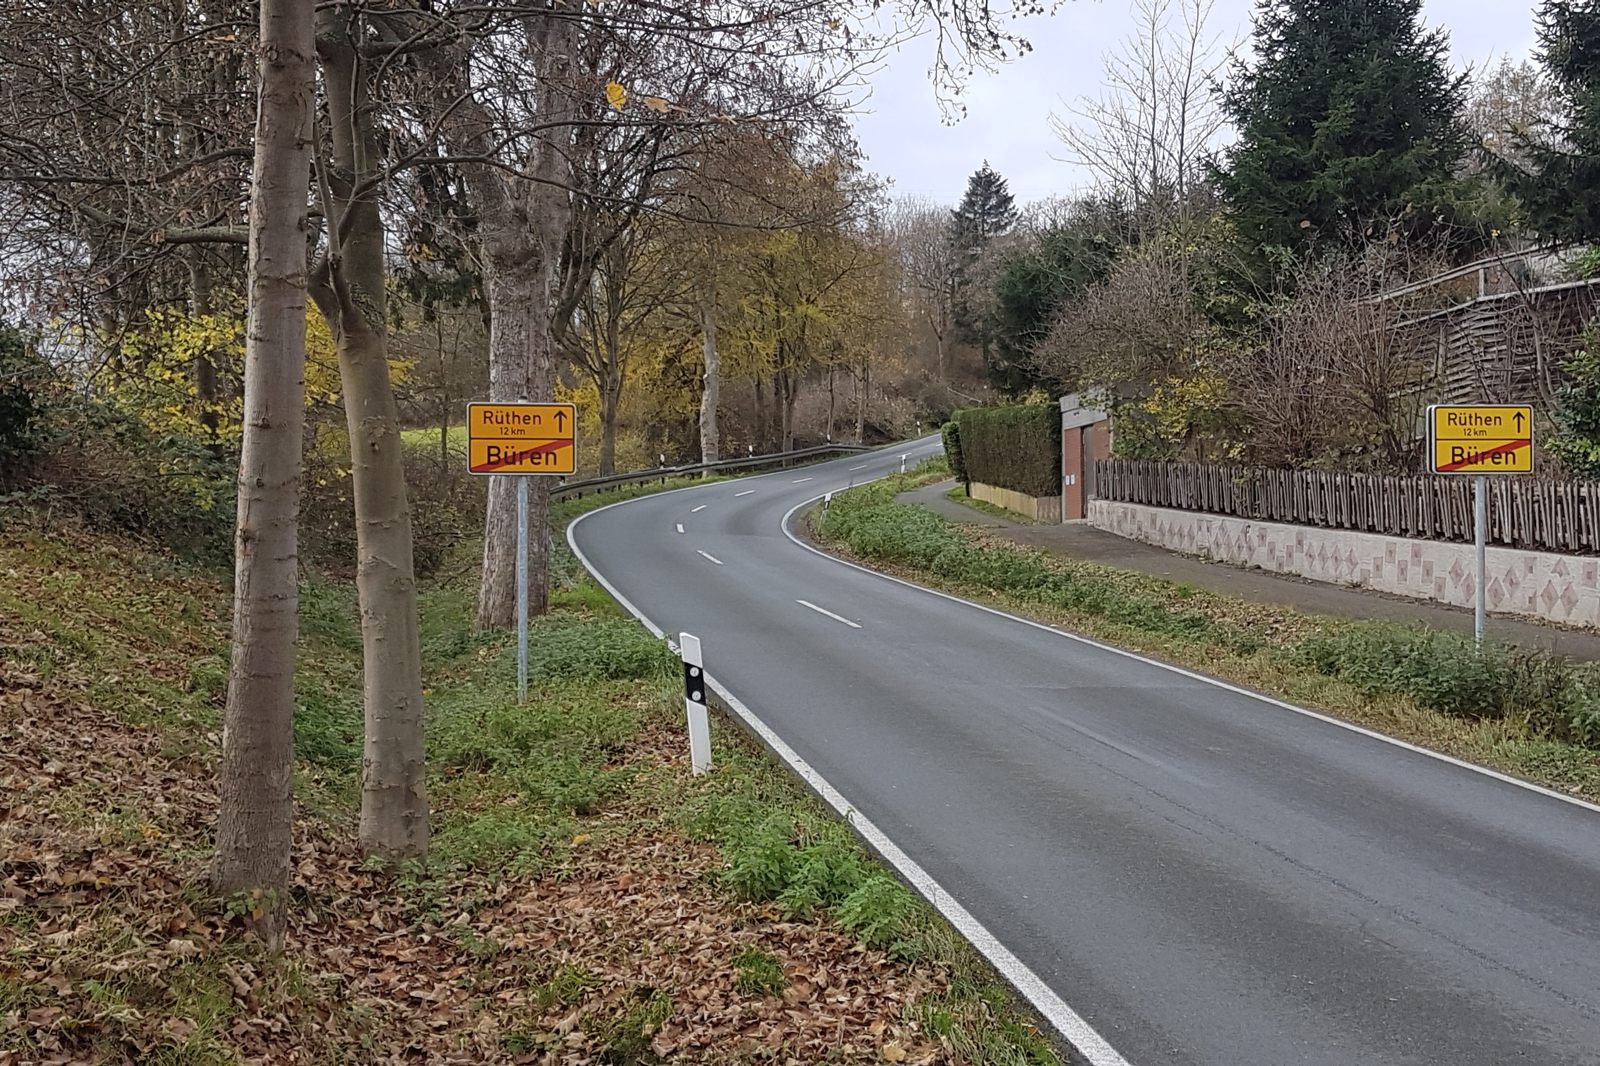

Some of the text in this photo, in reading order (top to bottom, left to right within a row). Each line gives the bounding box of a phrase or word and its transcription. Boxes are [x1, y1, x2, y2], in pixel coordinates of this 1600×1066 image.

[483, 410, 542, 425] Rüthen
[1447, 412, 1502, 426] Rüthen
[499, 427, 526, 435] 12 km
[1463, 428, 1488, 436] 12 km
[486, 445, 557, 466] Büren
[1451, 446, 1516, 465] Büren
